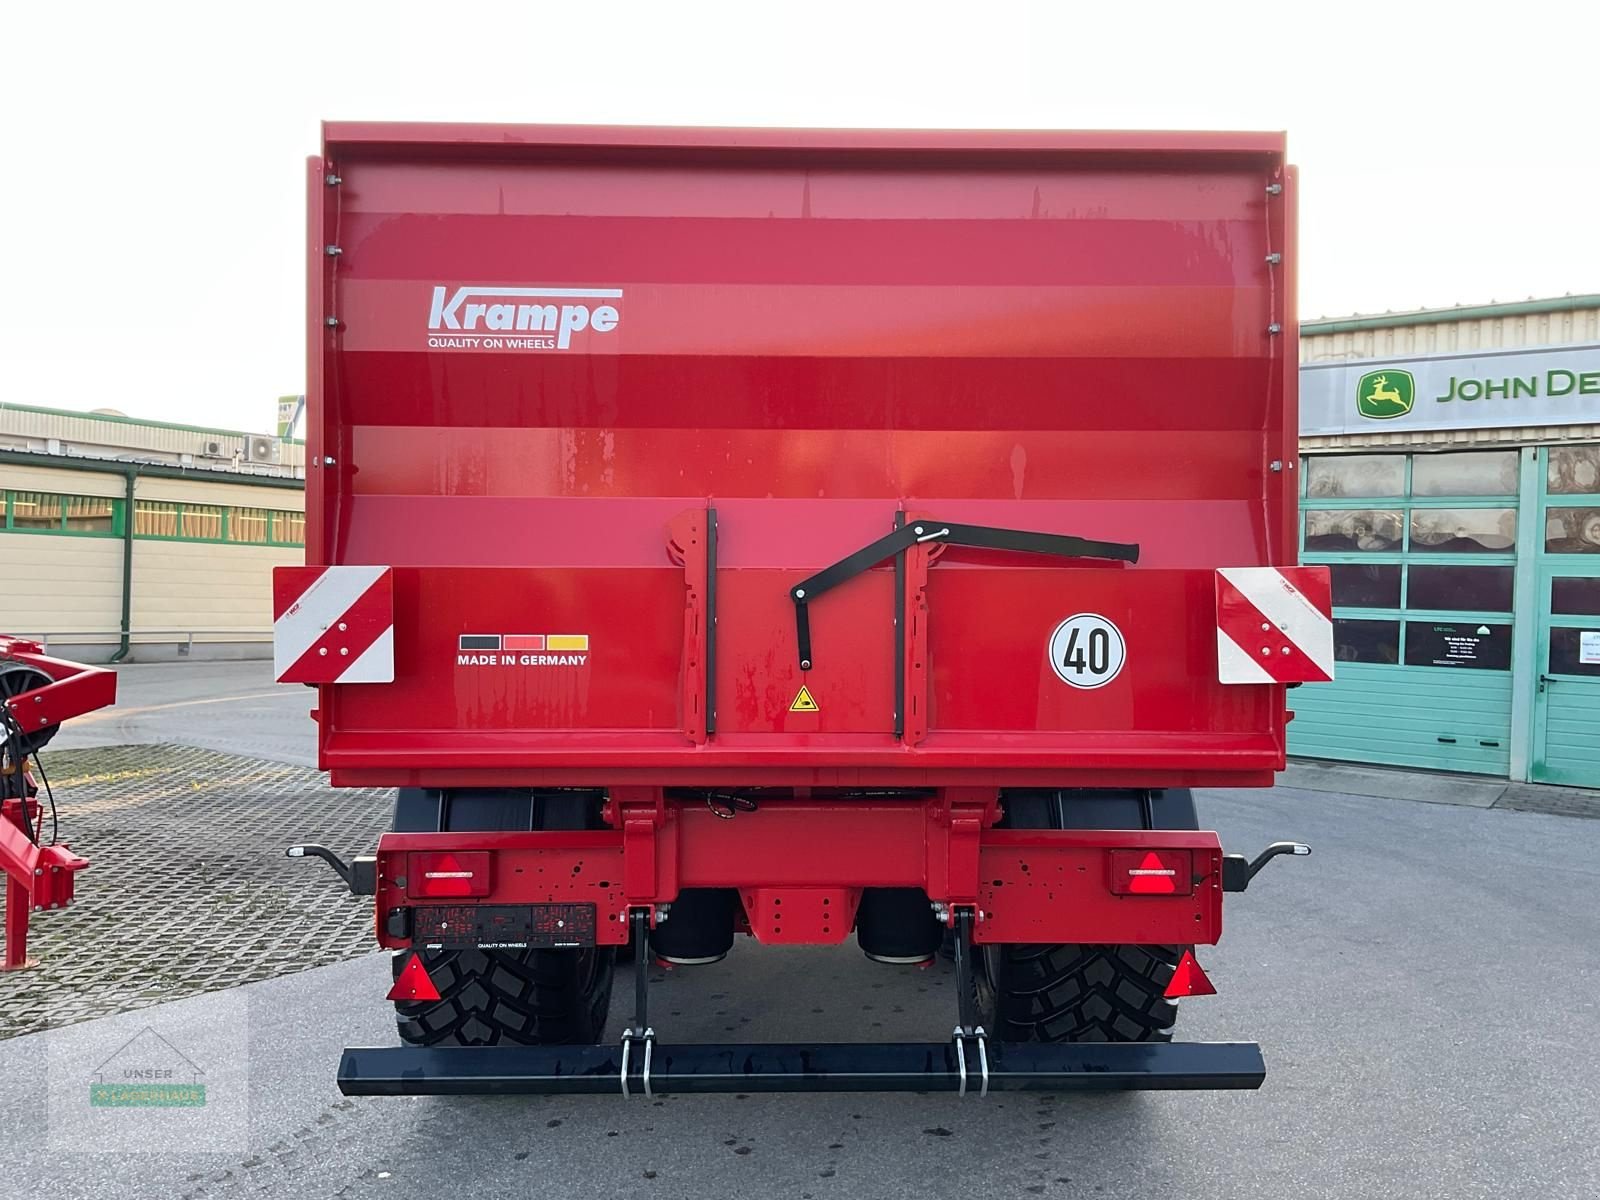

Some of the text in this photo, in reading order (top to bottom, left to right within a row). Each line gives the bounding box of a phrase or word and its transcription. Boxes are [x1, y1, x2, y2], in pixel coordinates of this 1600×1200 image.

[428, 286, 623, 350] Krampe
[428, 338, 555, 350] QUALITY ON WHEELS
[1436, 376, 1537, 403] JOHN
[457, 655, 587, 666] MADE IN GERMANY
[1063, 627, 1109, 675] 40
